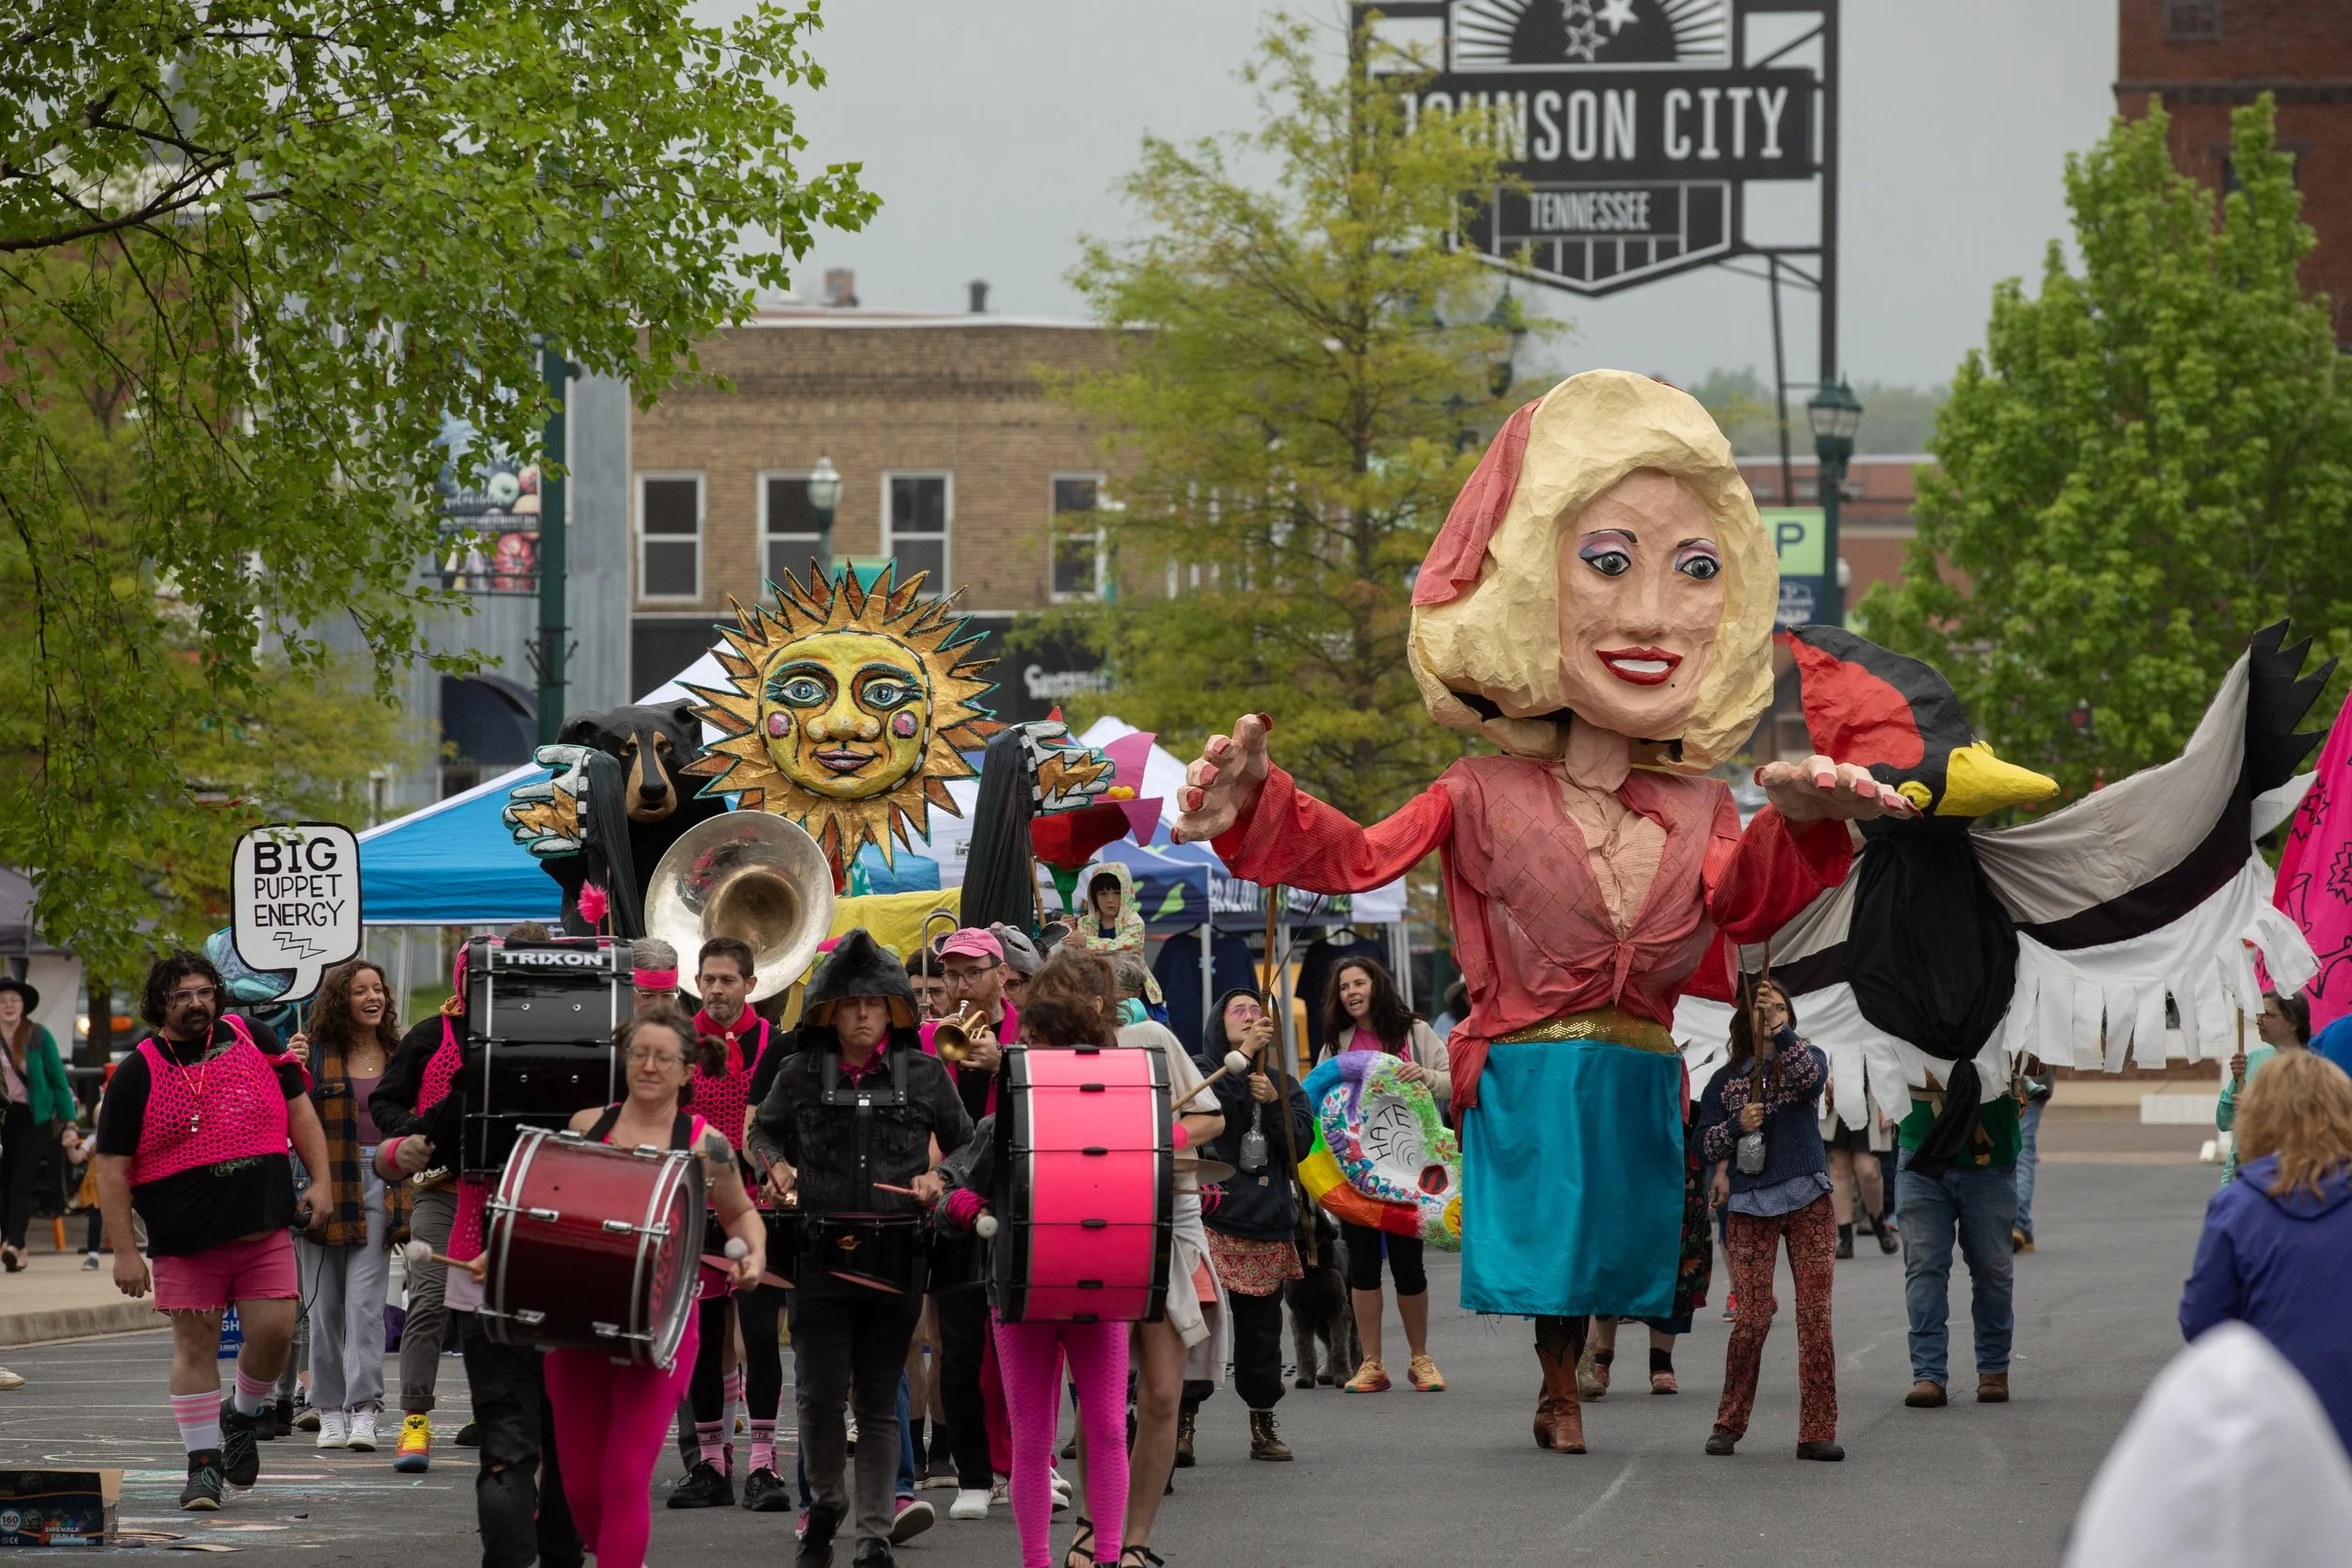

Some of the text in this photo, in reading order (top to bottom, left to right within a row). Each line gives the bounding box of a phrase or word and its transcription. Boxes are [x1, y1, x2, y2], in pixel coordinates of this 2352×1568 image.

[1663, 87, 1788, 160] CITY
[1529, 191, 1652, 231] TENNESSEE
[1776, 521, 1805, 558] P
[254, 836, 338, 875] BIG
[254, 874, 342, 899] PUPPET
[254, 899, 345, 927] ENERGY
[501, 952, 603, 966] TRIXON
[1369, 1103, 1411, 1162] HATE
[2, 1515, 19, 1525] 160
